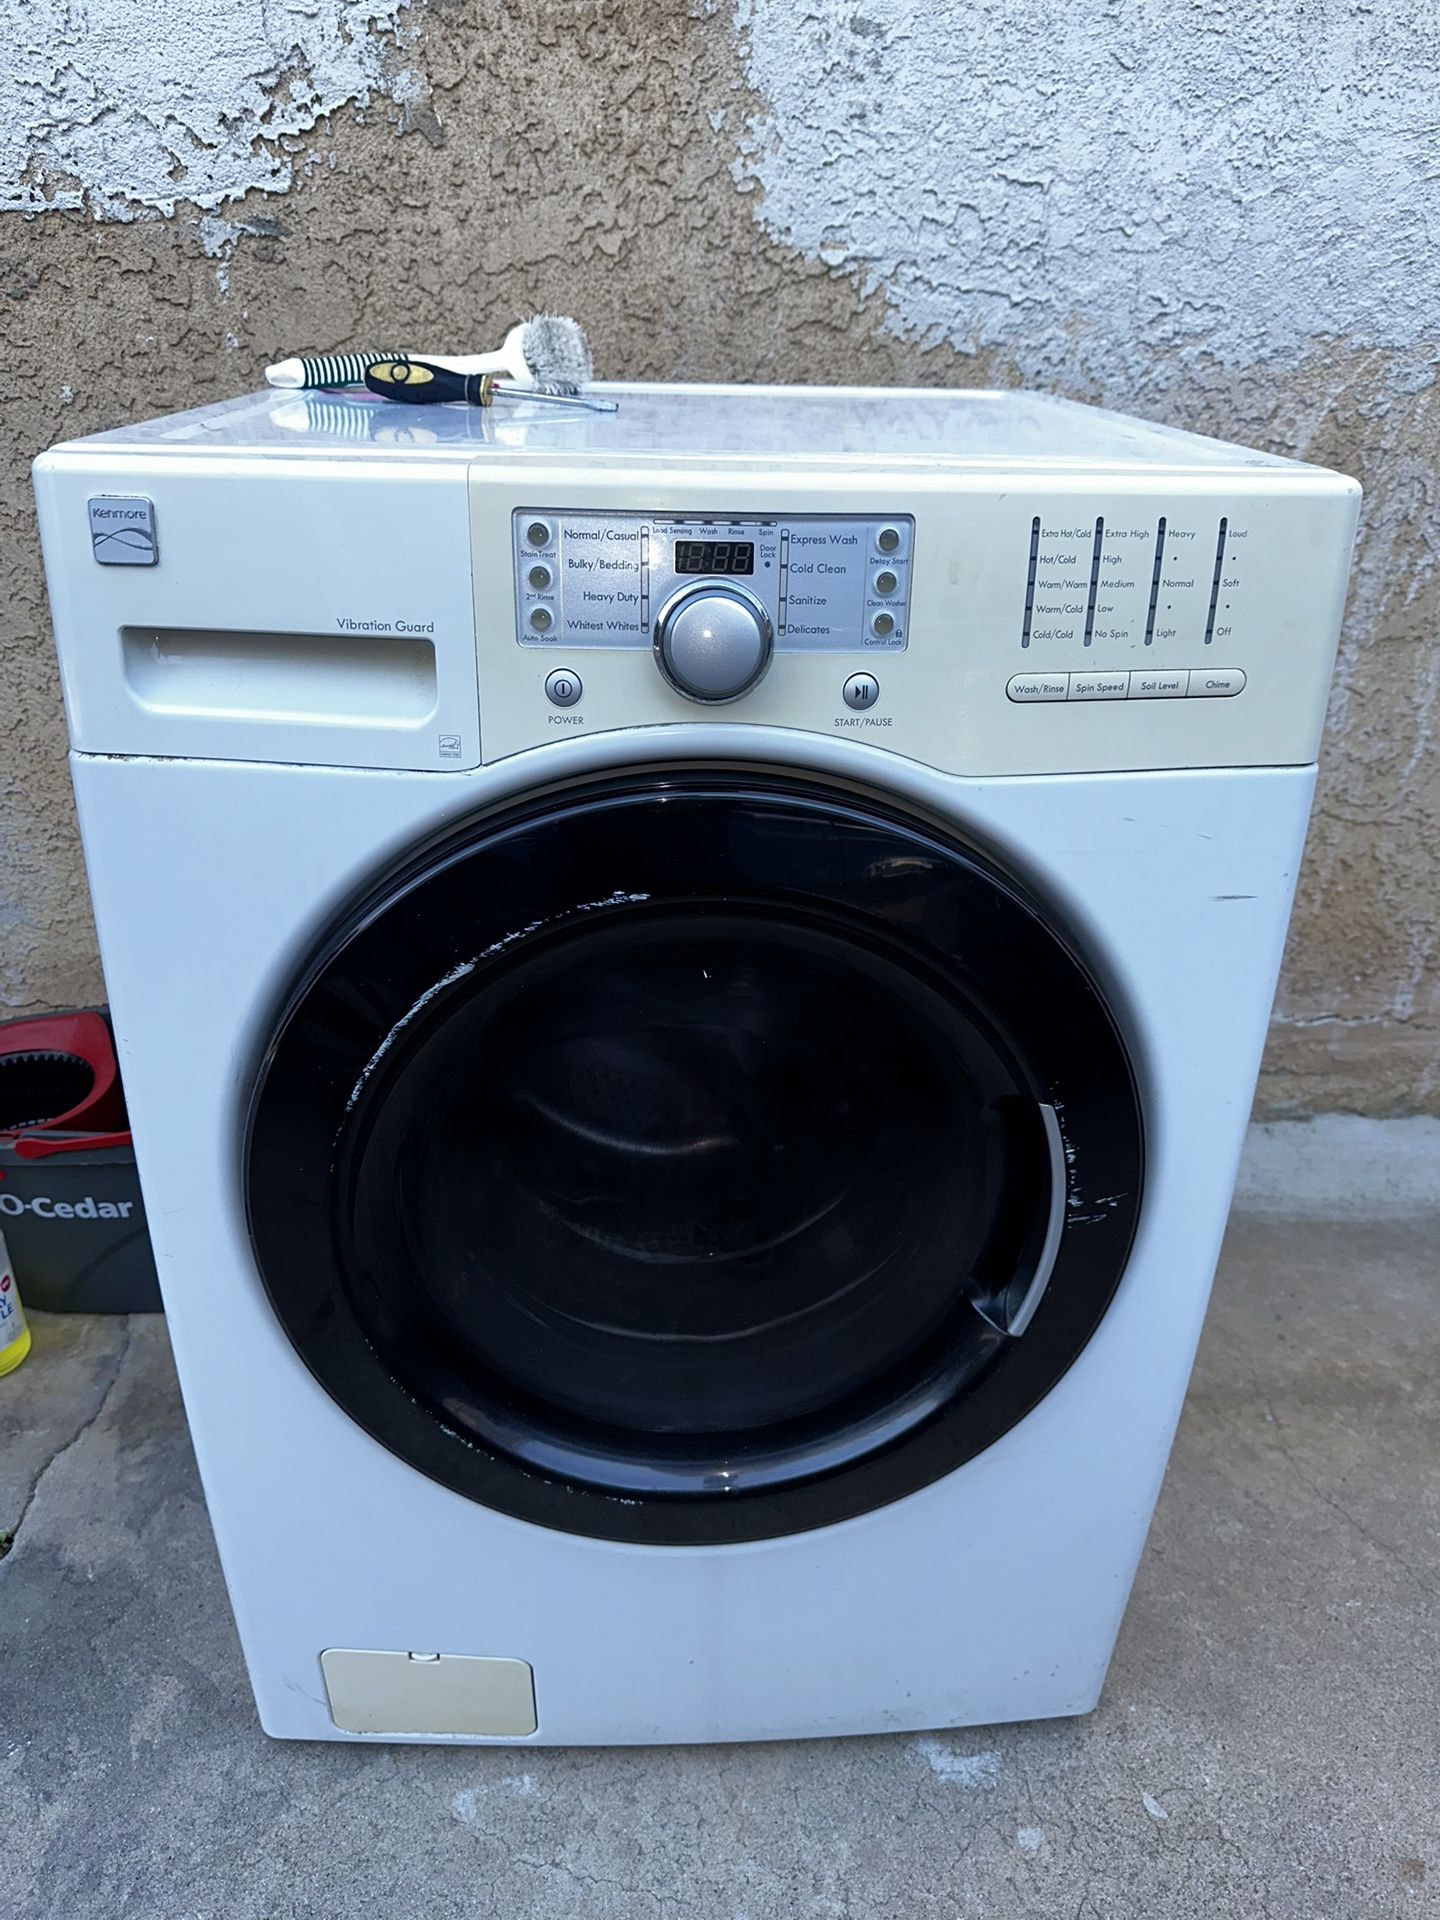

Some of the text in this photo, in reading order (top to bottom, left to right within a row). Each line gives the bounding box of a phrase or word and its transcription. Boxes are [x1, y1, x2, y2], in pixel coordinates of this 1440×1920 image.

[92, 508, 147, 520] Kenmore
[564, 528, 639, 542] Normal/Casual
[1041, 529, 1092, 540] Extra Hot/Cold
[1105, 530, 1150, 540] Extra High
[1168, 530, 1196, 540] Heavy
[1229, 529, 1247, 538] Loud
[791, 534, 858, 546] Express Wash
[760, 544, 776, 552] Door
[870, 557, 890, 566] Delay
[1039, 554, 1076, 565] Hot/Cold
[1102, 555, 1122, 565] High
[568, 558, 639, 572] Bulky/Bedding
[790, 564, 846, 574] Cold Clean
[1038, 580, 1088, 590] Warm/Warm
[1101, 580, 1135, 588] Medium
[1162, 579, 1194, 588] Normal
[1222, 579, 1239, 588] Soft
[583, 591, 639, 605] Heavy Duty
[789, 596, 827, 606] Sanitize
[866, 599, 884, 607] Clean
[1036, 604, 1084, 615] Warm/Cold
[1097, 604, 1114, 613] Low
[336, 618, 435, 633] Vibration Guard
[567, 620, 639, 631] Whitest Whites
[787, 624, 831, 635] Delicates
[1033, 629, 1073, 640] Cold/Cold
[1095, 629, 1129, 640] No Spin
[1156, 628, 1176, 639] Light
[1216, 627, 1232, 636] Off
[1014, 683, 1064, 694] Wash/Rinse
[1076, 683, 1124, 693] Spin Speed
[1141, 681, 1179, 690] Soil Level
[1205, 680, 1231, 689] Chime
[548, 715, 584, 725] POWER
[834, 718, 893, 729] START/PAUSE
[0, 1194, 133, 1219] O-Cedar
